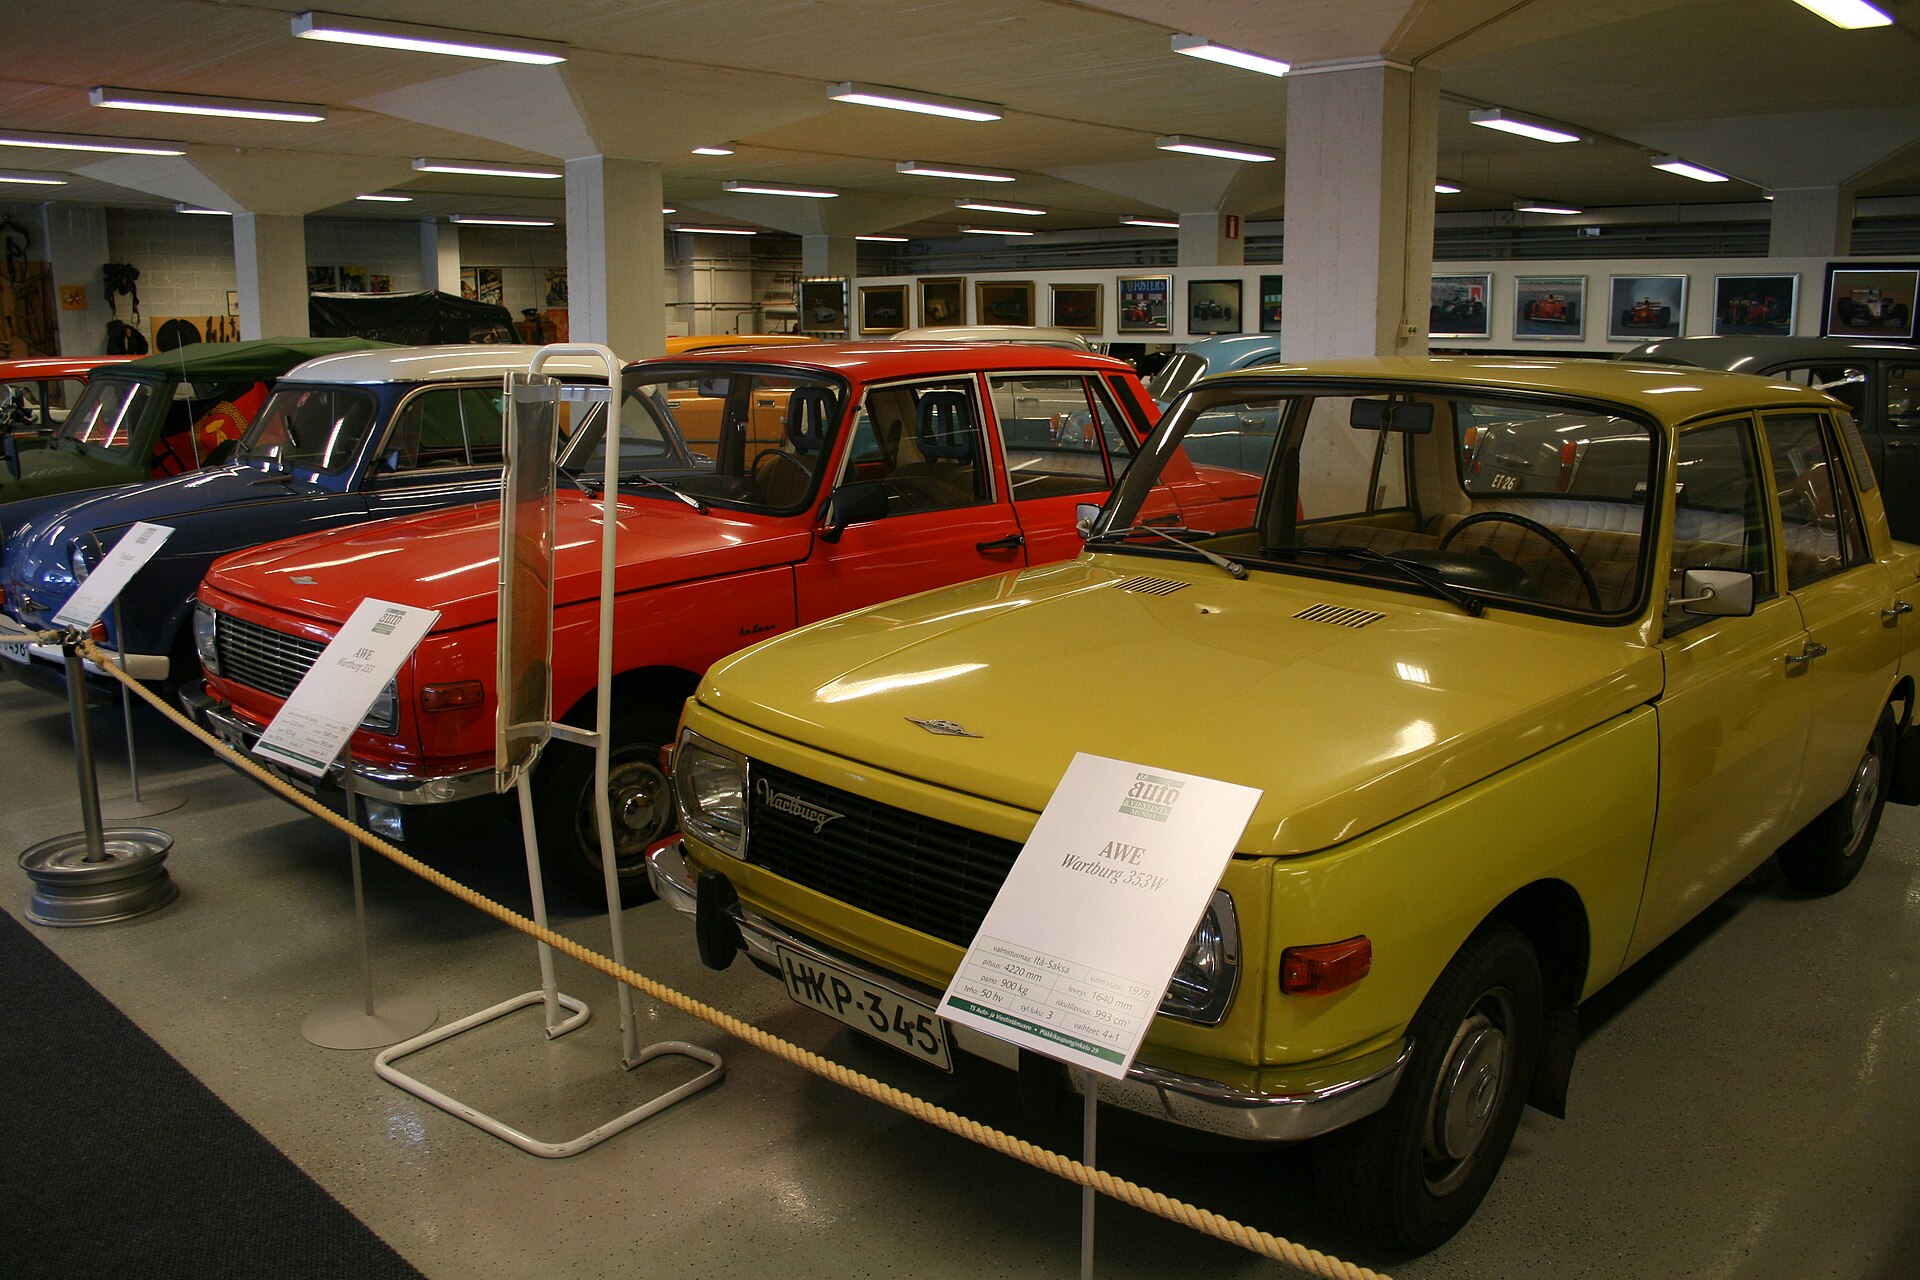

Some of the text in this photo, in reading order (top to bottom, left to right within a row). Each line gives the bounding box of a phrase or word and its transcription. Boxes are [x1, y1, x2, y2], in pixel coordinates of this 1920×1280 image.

[353, 647, 375, 661] AWE
[1127, 781, 1181, 806] auto
[756, 778, 845, 834] Wartburg
[1098, 840, 1146, 866] AWE
[1061, 853, 1169, 892] Wartburg 353W
[1003, 963, 1026, 977] 4220
[1025, 970, 1043, 982] mm
[1033, 955, 1070, 974] Itä-Saksa
[980, 988, 994, 999] 50
[993, 992, 1004, 1003] hv
[1000, 978, 1018, 991] 900
[1017, 984, 1030, 997] kg
[1127, 984, 1151, 999] 1978
[786, 956, 939, 1056] HKP-345
[1091, 990, 1114, 1005] 1640
[1114, 1000, 1133, 1011] mm
[1046, 1010, 1054, 1020] 3
[1093, 1009, 1113, 1022] 993
[1102, 1029, 1121, 1042] 4+1
[1090, 1046, 1100, 1054] 29
